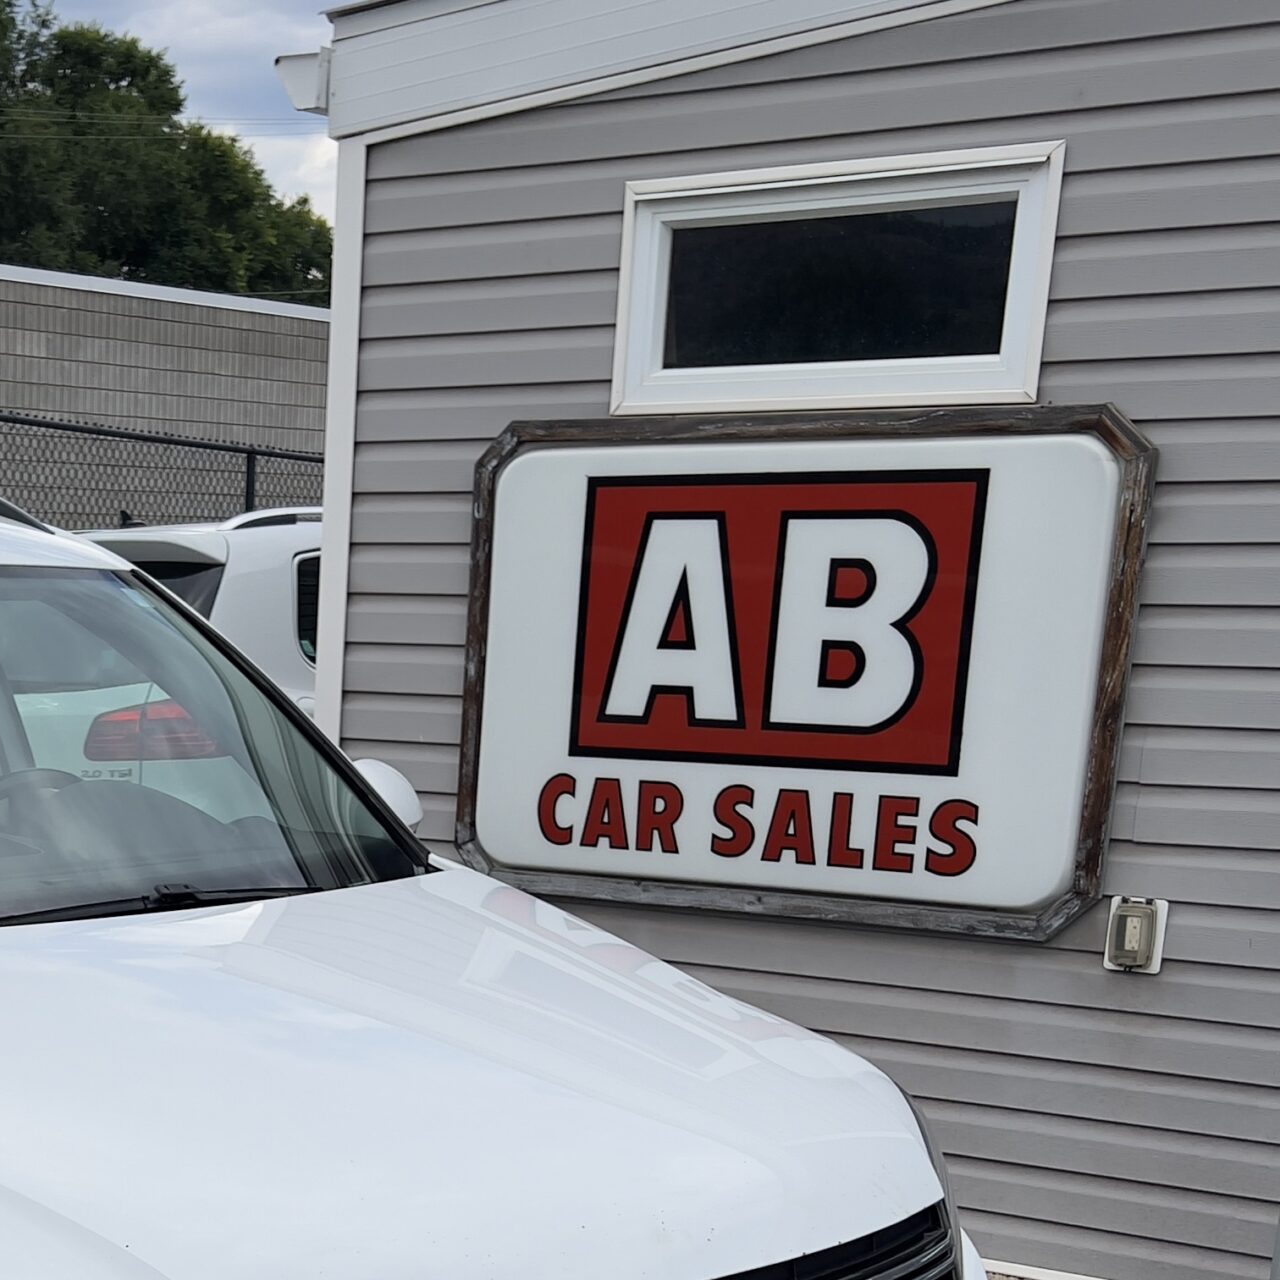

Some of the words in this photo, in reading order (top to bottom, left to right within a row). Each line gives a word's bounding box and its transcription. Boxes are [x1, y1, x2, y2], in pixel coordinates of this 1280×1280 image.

[597, 510, 937, 735] AB
[537, 773, 684, 854] CAR
[711, 784, 980, 877] SALES
